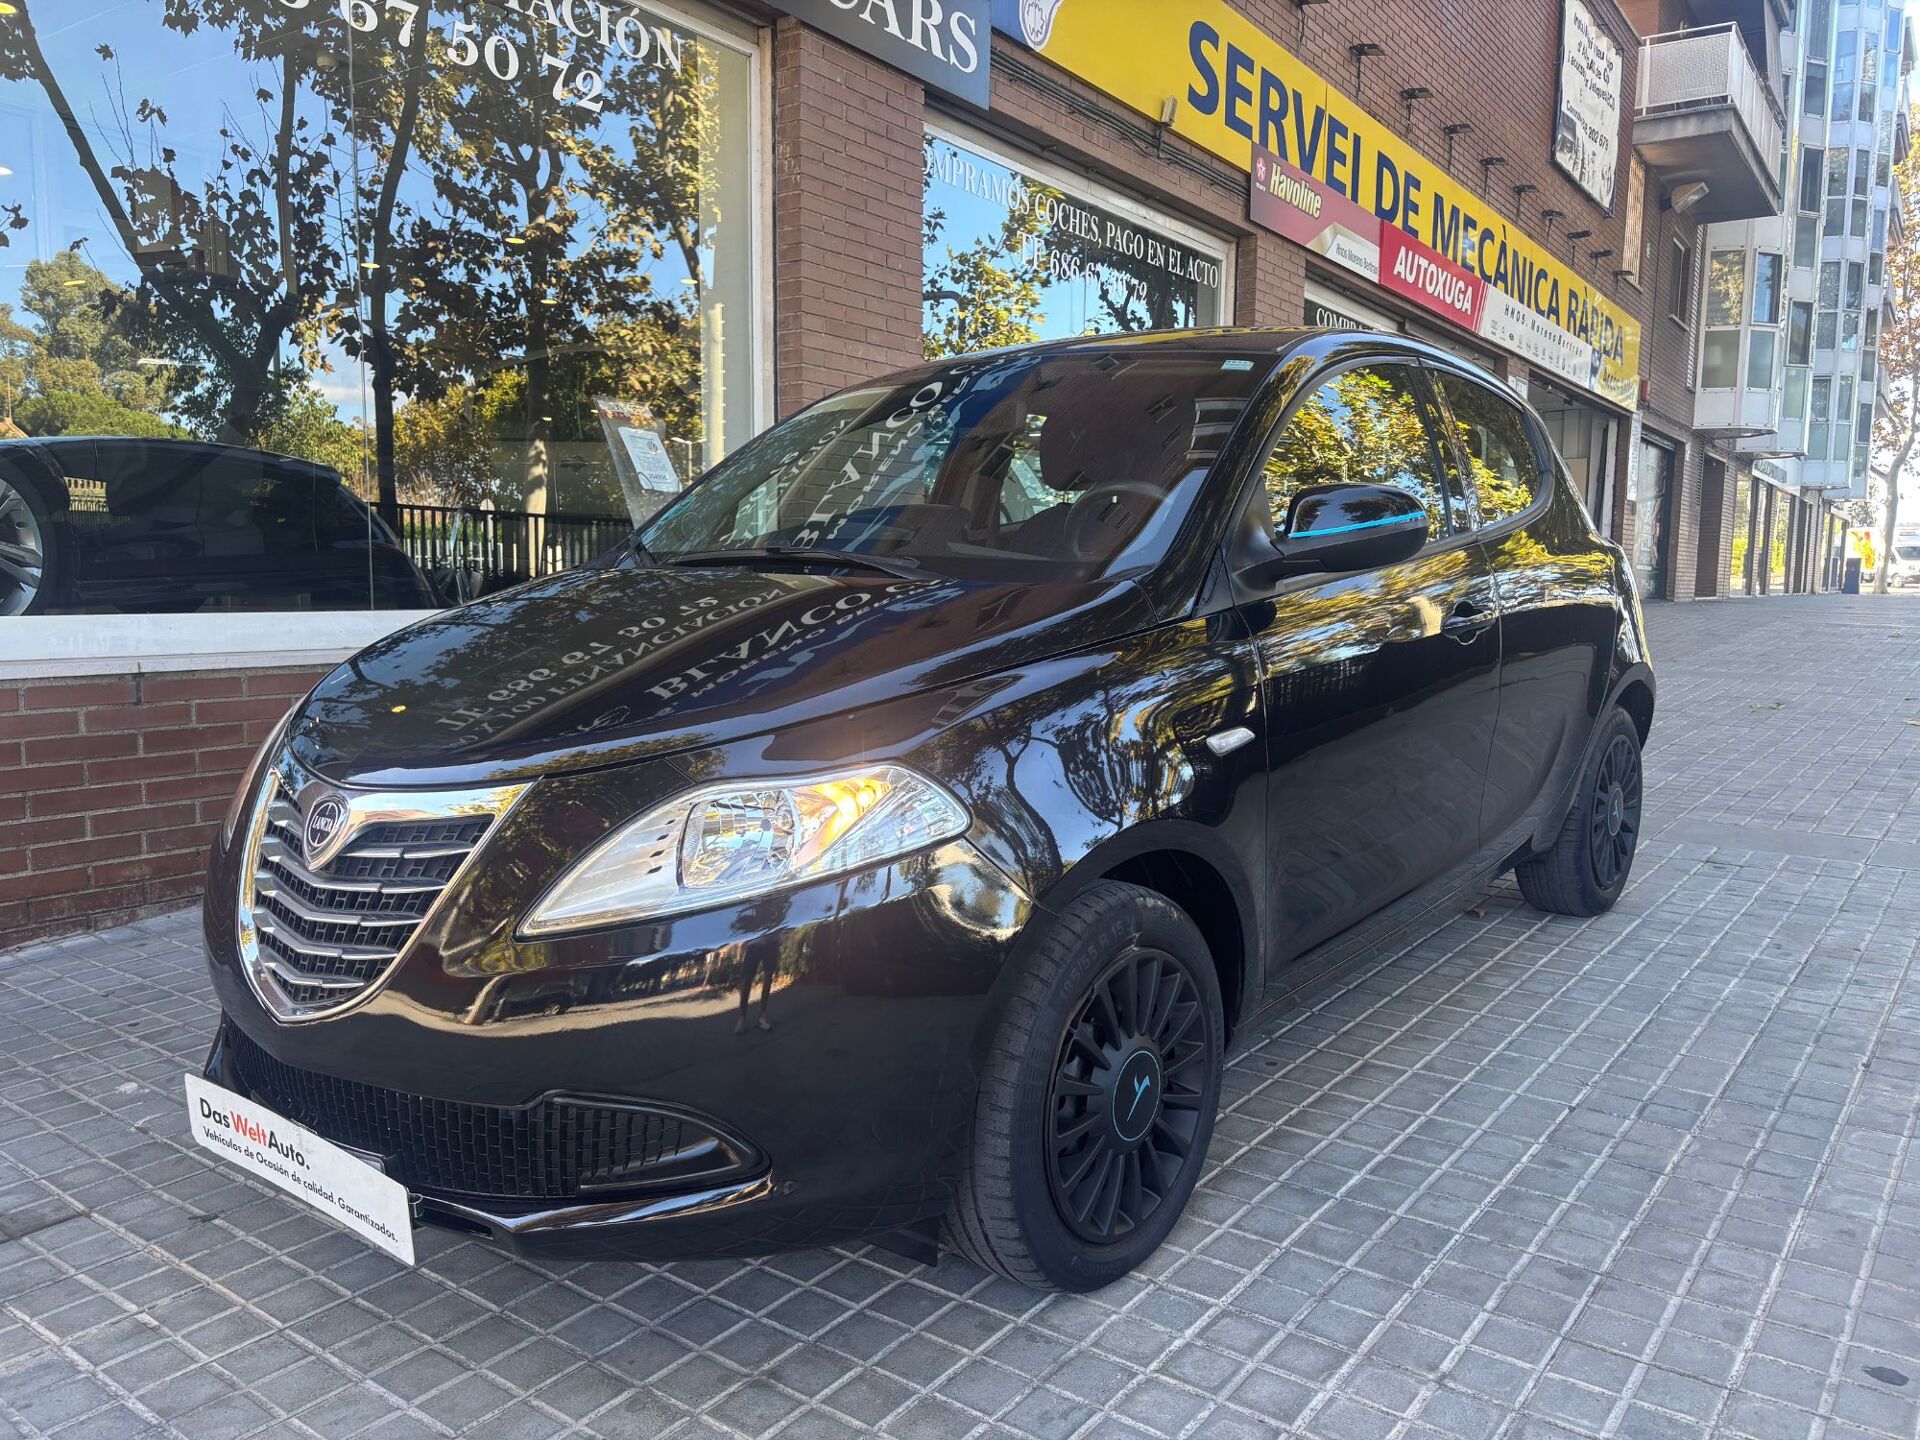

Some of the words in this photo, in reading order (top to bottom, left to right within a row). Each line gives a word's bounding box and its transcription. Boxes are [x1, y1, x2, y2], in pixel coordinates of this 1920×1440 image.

[446, 19, 520, 82] 50
[541, 52, 605, 112] 72
[505, 0, 688, 77] ACIÓN
[829, 0, 978, 73] ARS
[923, 143, 1030, 215] OMPRAMOS
[1034, 191, 1102, 249] COCHES,
[1106, 221, 1144, 259] PAGO
[1147, 238, 1166, 267] EN
[1167, 246, 1186, 276] EL
[1187, 255, 1218, 289] ACTO
[1188, 20, 1362, 204] SERVEI
[1375, 150, 1421, 241] DE
[1432, 192, 1561, 327] MECÀNICA
[1567, 286, 1624, 366] RÀPIDA
[1270, 162, 1322, 220] Havoline
[1049, 249, 1080, 281] 686
[1393, 246, 1473, 315] AUTOXUGA
[244, 1146, 255, 1160] de
[255, 1151, 290, 1179] Ocasión
[291, 1171, 302, 1185] de
